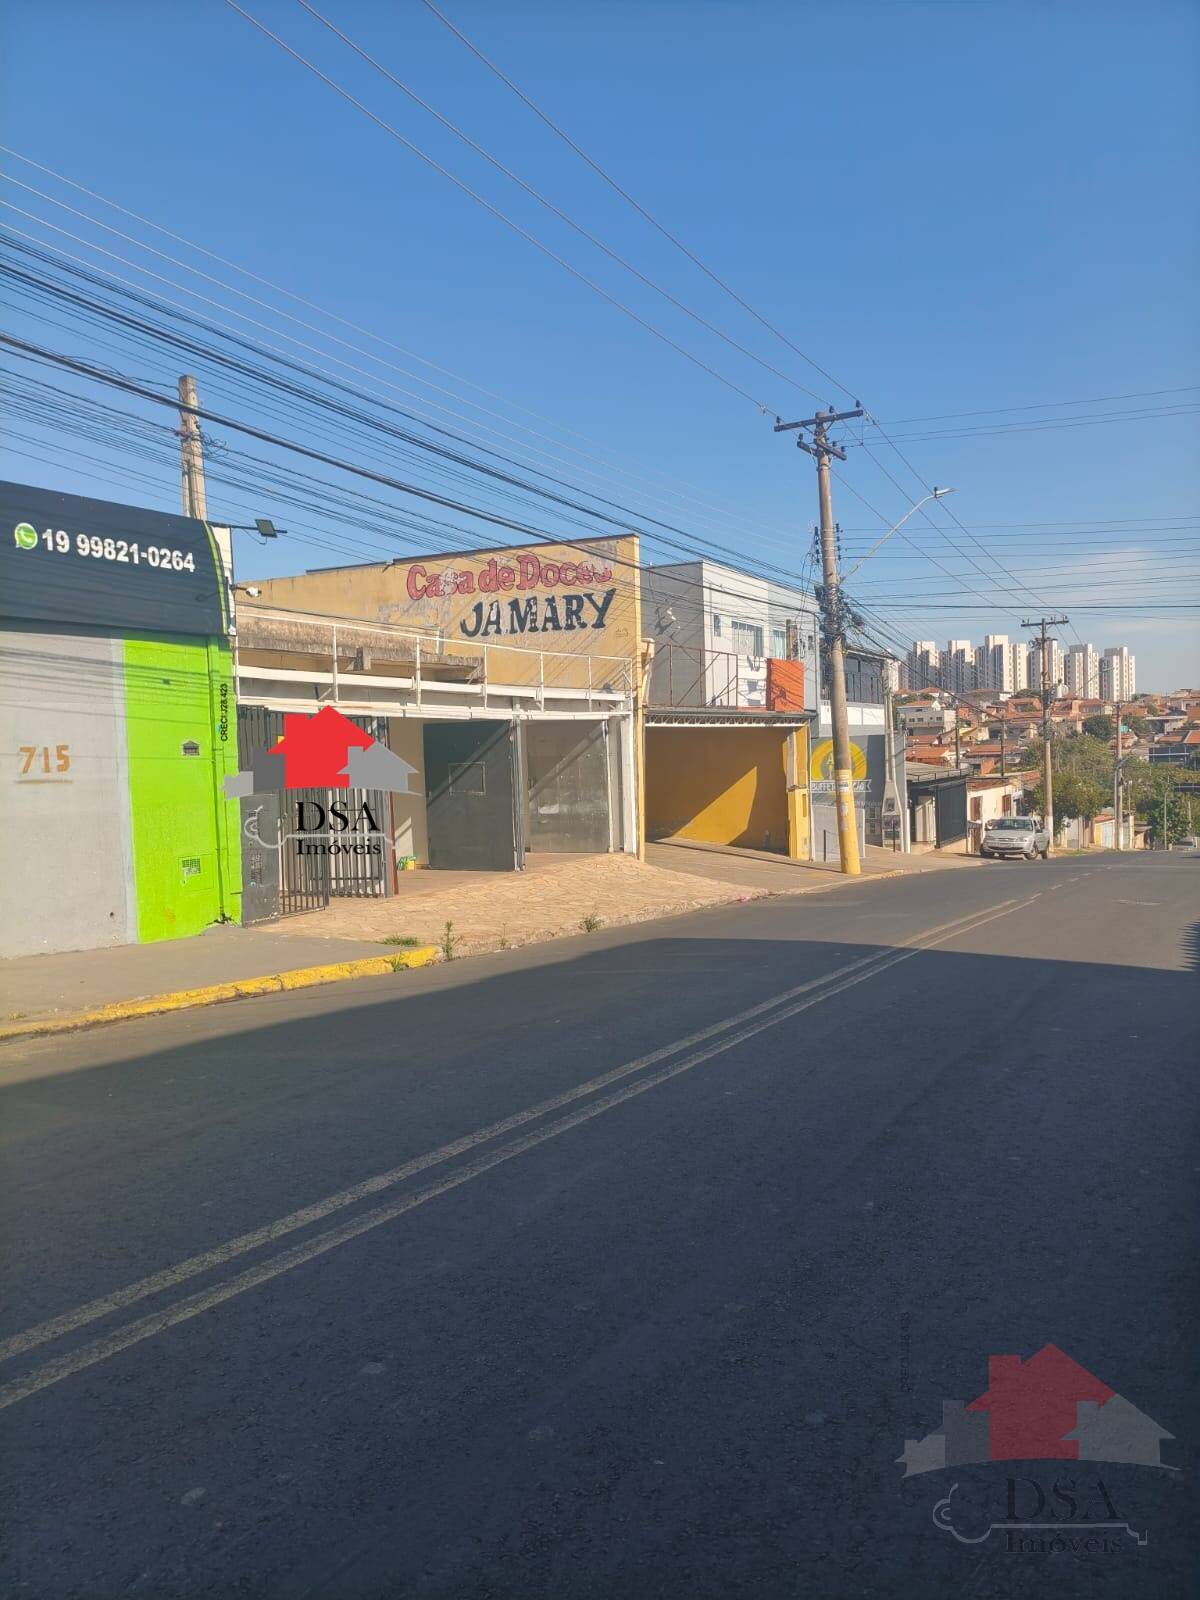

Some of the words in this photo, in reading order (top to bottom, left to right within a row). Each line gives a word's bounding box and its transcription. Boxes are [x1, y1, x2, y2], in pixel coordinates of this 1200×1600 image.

[42, 528, 70, 553] 19
[76, 533, 196, 573] 99821-0264
[478, 557, 516, 594] de
[460, 587, 617, 638] JAMARY
[19, 744, 71, 775] 715
